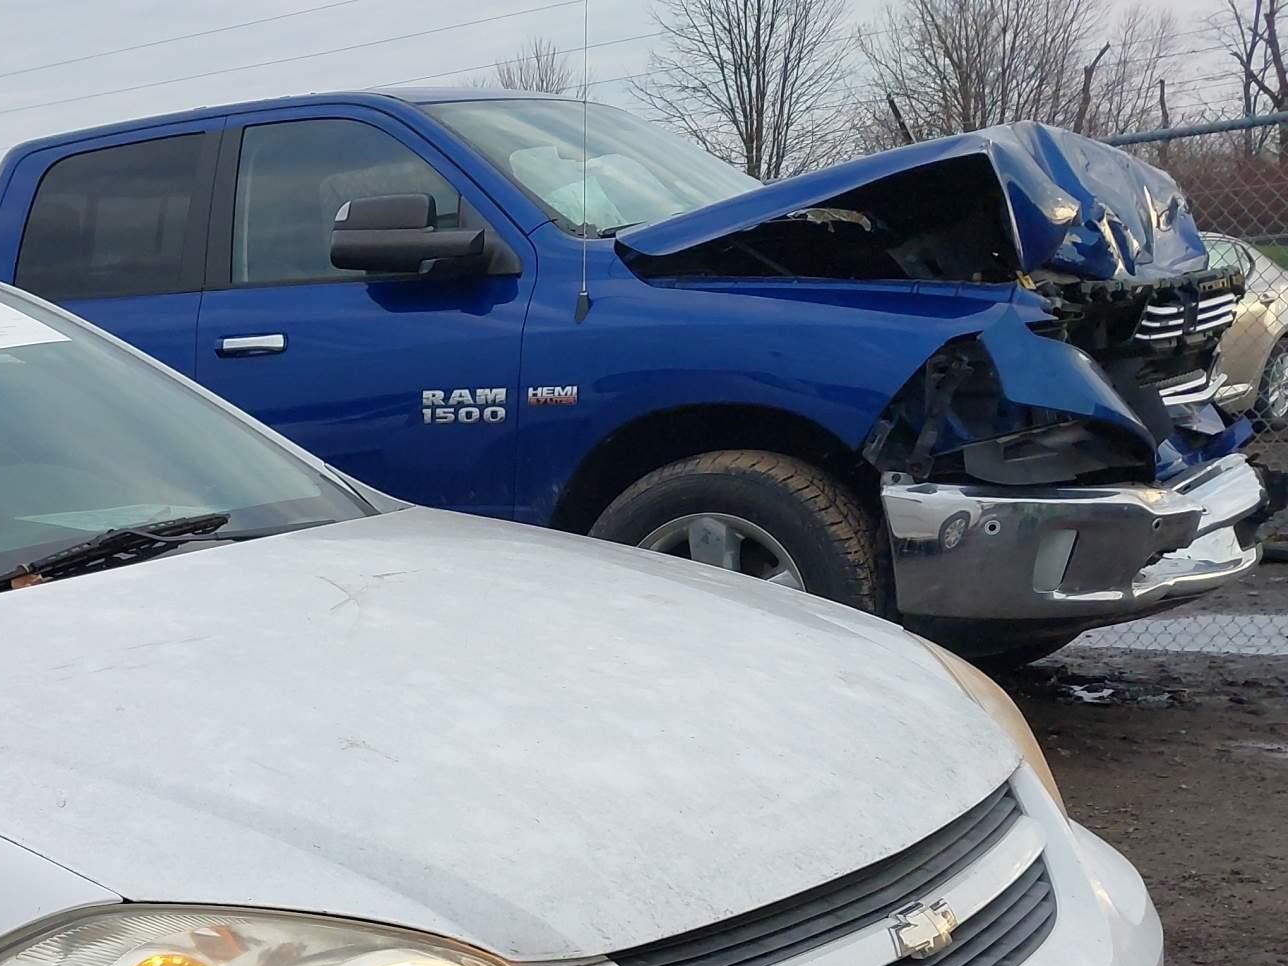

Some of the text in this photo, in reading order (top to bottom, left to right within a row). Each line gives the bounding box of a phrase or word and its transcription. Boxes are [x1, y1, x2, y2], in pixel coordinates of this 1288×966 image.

[422, 388, 506, 406] RAM
[528, 386, 578, 398] HEMI
[422, 406, 506, 424] 1500
